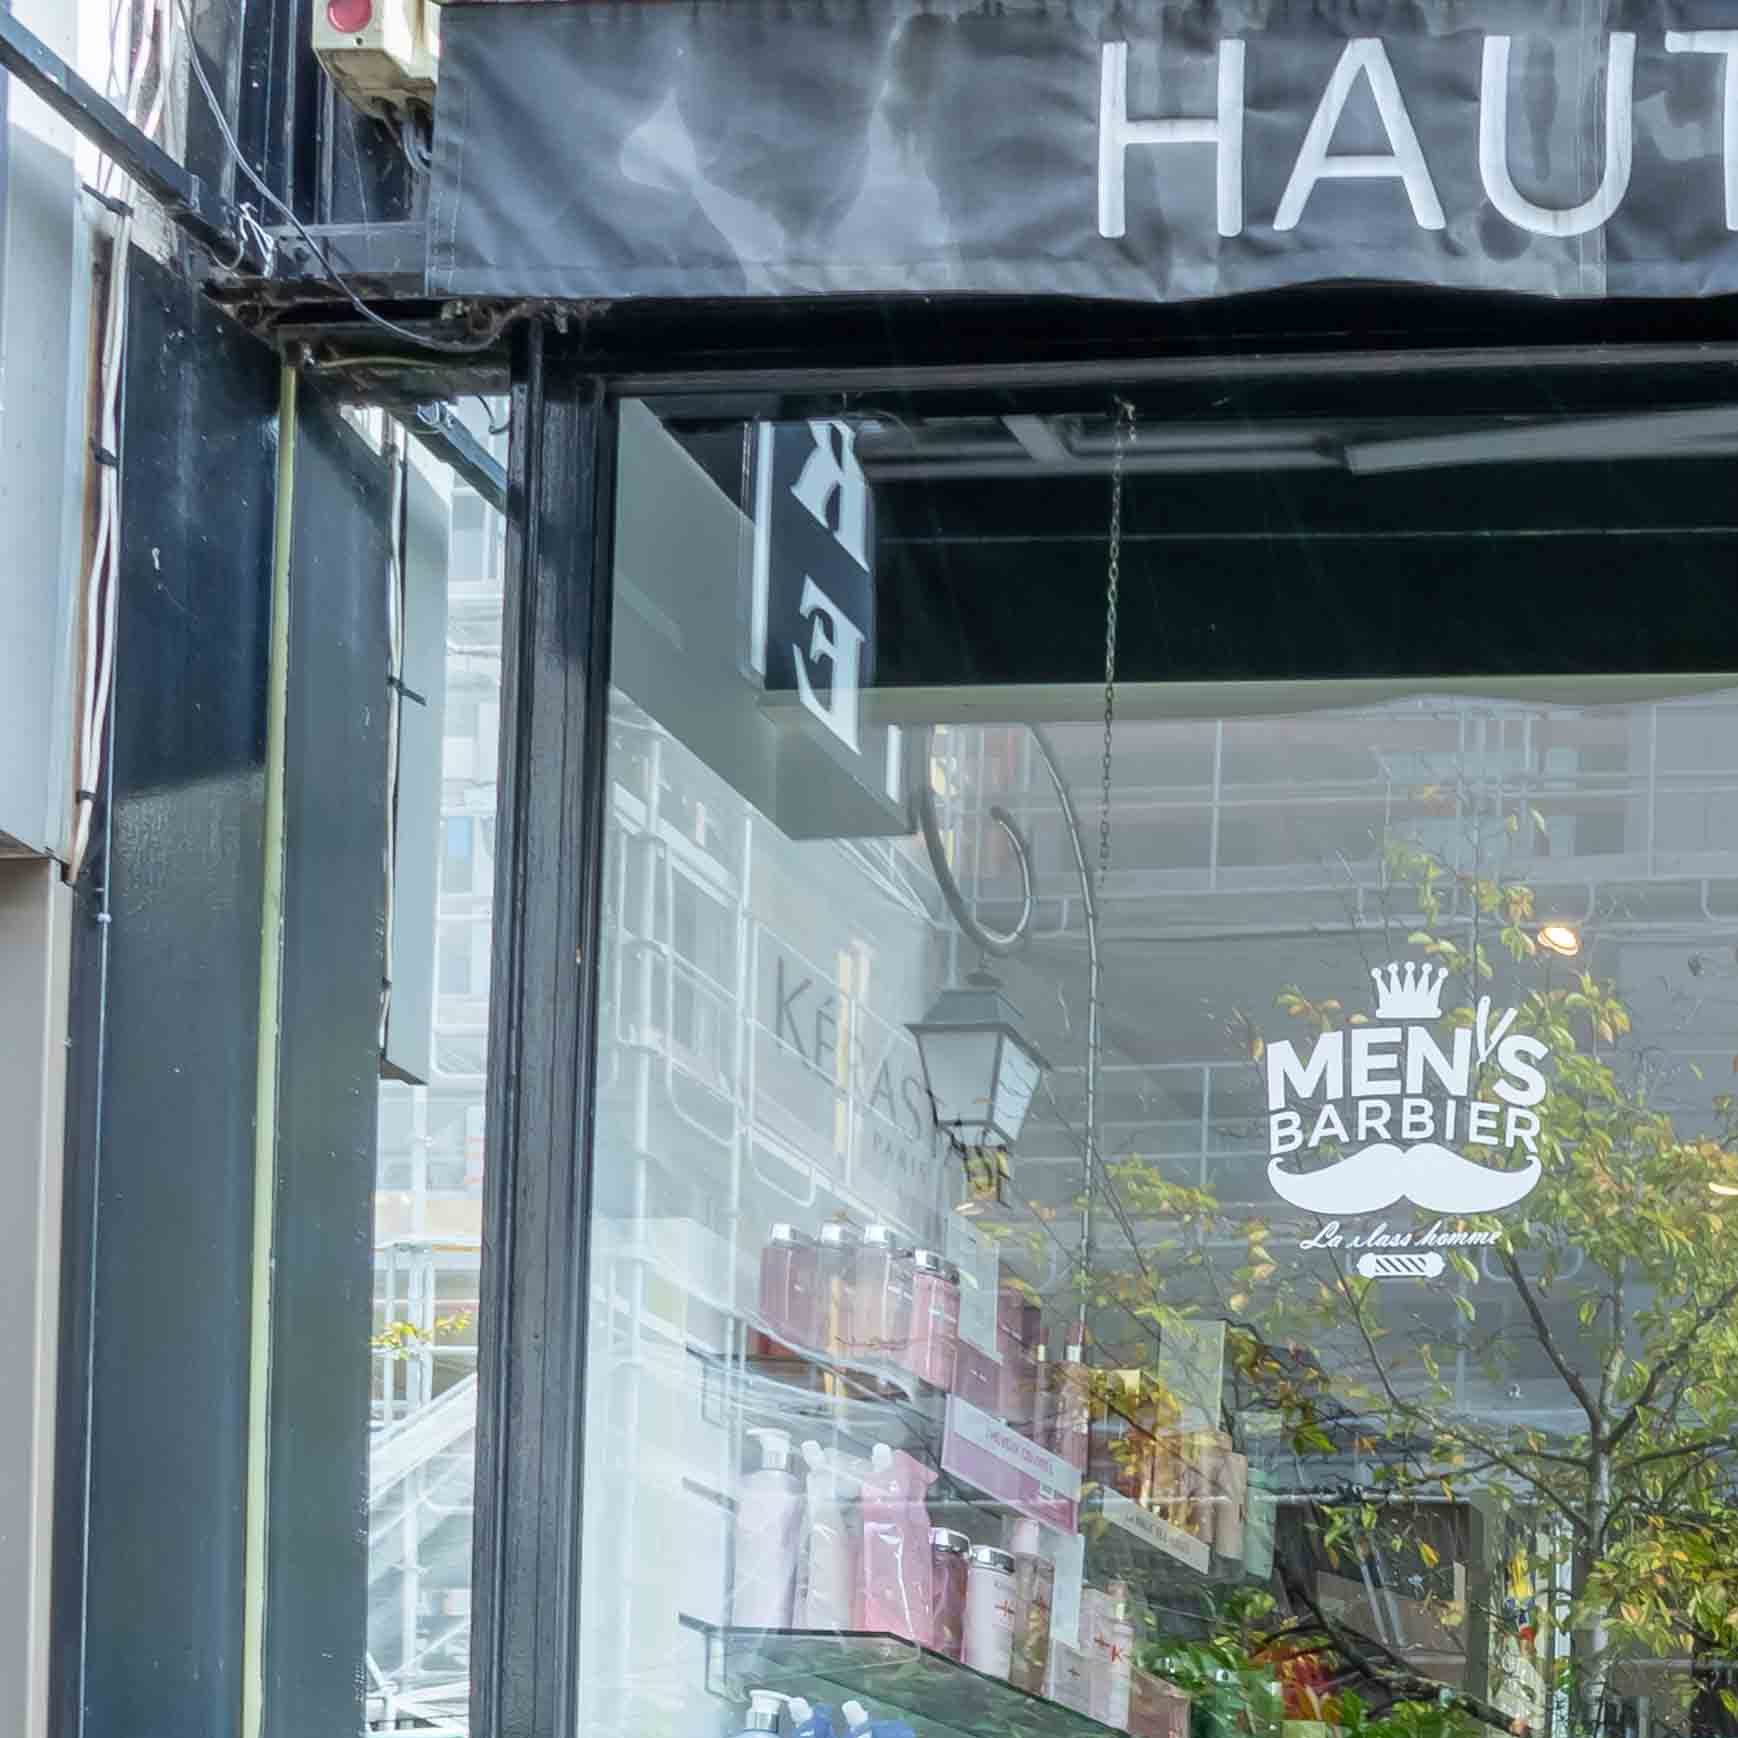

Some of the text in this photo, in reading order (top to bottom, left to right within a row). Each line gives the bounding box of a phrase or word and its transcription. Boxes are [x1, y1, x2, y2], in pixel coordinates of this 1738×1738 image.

[1266, 996, 1550, 1111] MEN'S
[1269, 1098, 1541, 1154] BARBIER
[1415, 1219, 1502, 1248] homme
